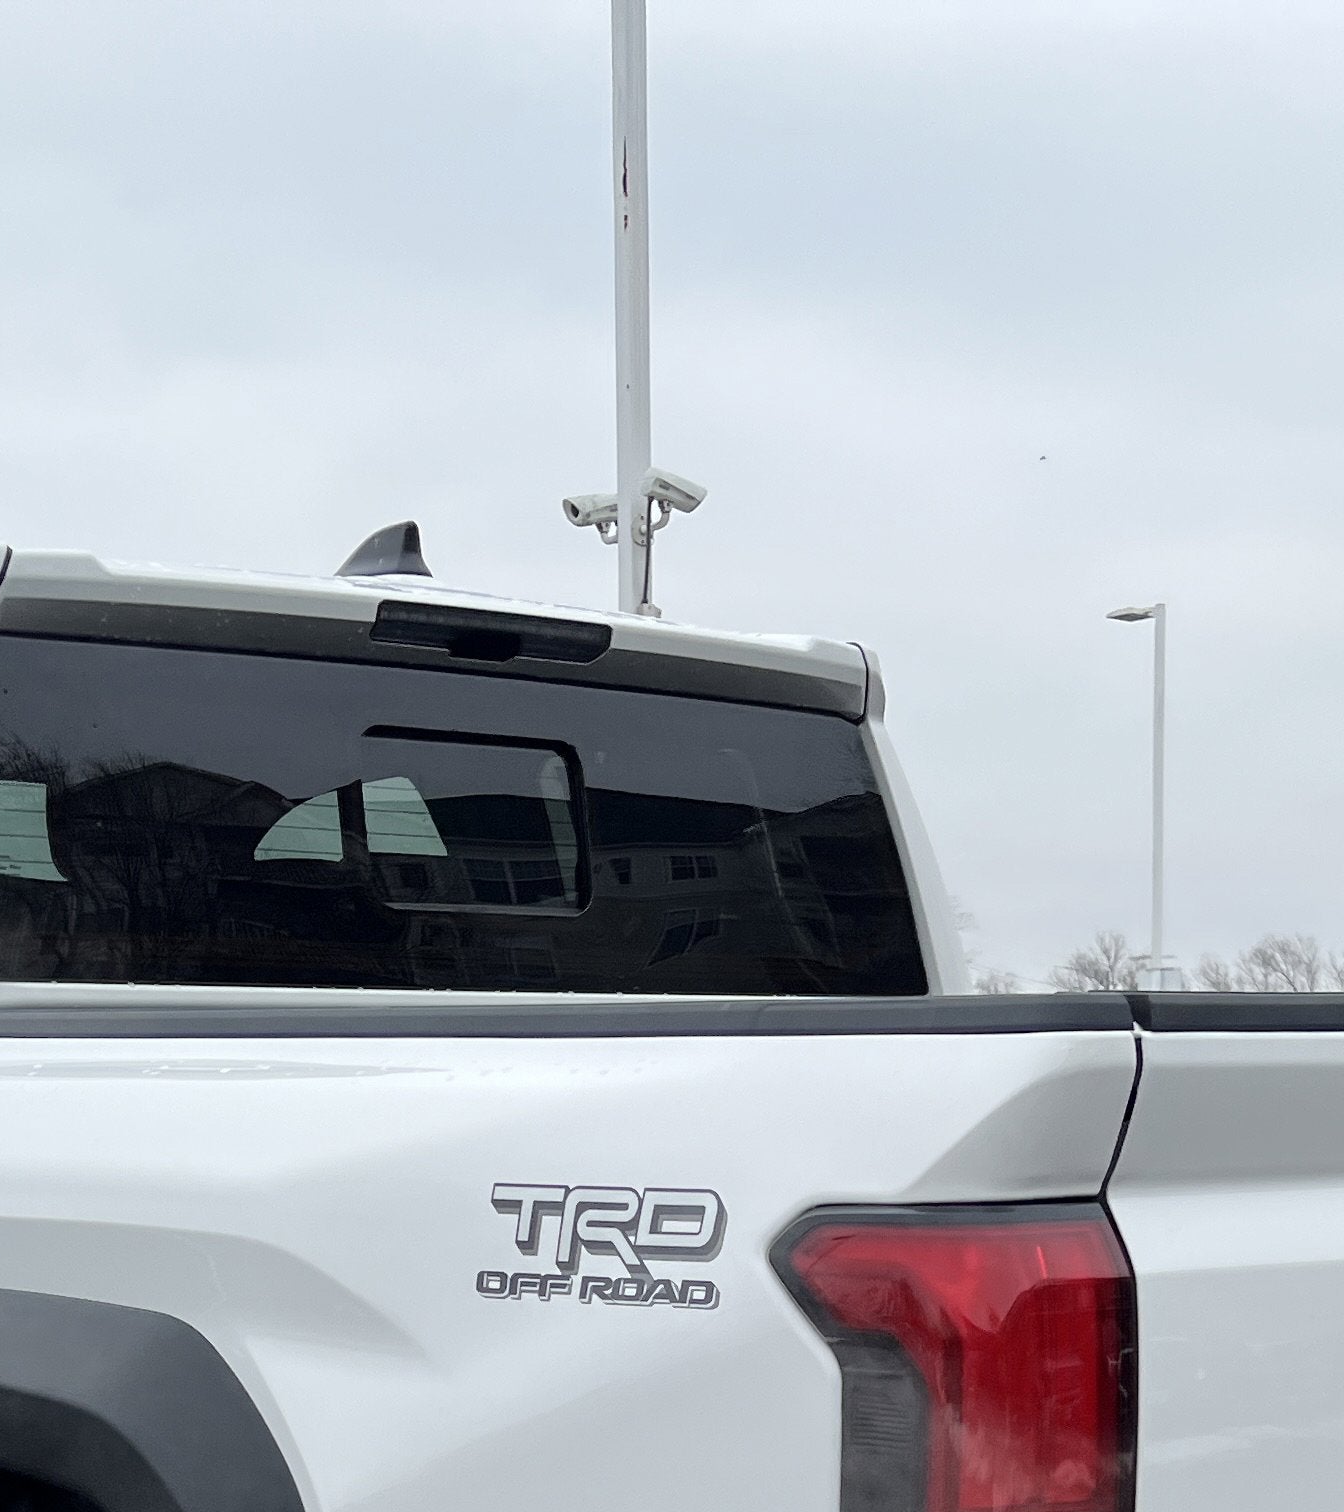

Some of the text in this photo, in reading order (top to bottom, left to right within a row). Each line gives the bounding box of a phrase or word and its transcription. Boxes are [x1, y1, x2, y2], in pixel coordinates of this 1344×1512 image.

[491, 1183, 728, 1276] TRD
[476, 1270, 721, 1310] OFF ROAD
